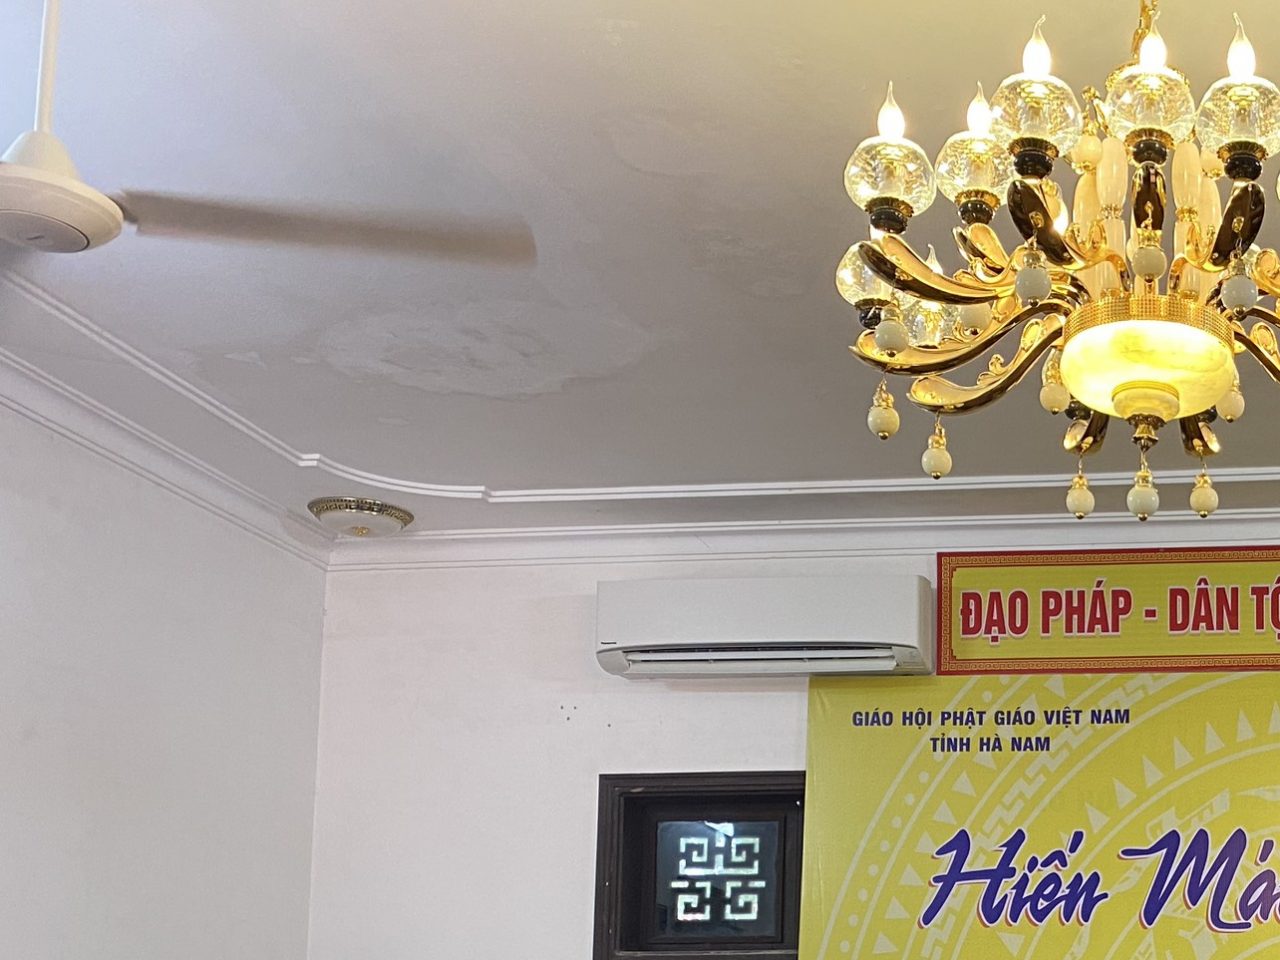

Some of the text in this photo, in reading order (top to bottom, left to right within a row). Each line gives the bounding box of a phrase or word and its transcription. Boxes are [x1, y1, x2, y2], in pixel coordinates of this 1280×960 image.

[960, 590, 1029, 643] ĐẠO
[1041, 579, 1132, 635] PHÁP
[1168, 577, 1240, 632] DÂN
[852, 705, 1131, 730] GIÁO HỘI PHẬT GIÁO VIỆT NAM
[930, 733, 1050, 752] TỈNH HÀ NAM
[920, 828, 1109, 927] Hiến
